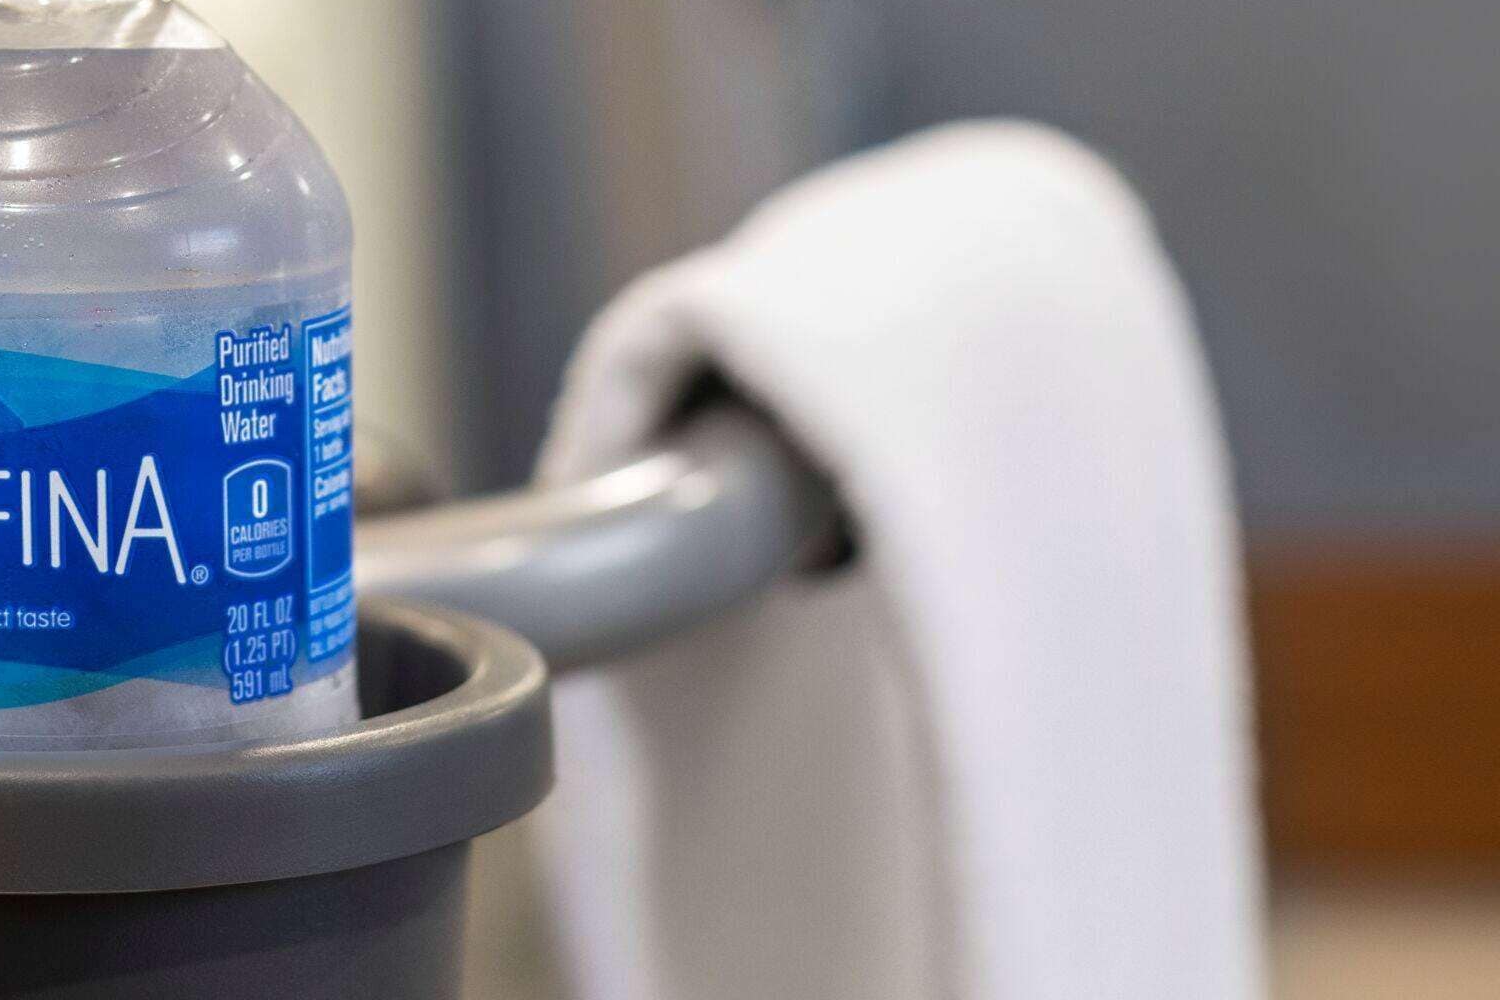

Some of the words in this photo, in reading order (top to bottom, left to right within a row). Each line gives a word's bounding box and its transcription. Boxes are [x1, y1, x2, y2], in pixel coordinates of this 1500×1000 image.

[219, 327, 290, 369] Purified
[220, 368, 294, 407] Drinking
[220, 408, 277, 444] Water
[252, 479, 269, 519] 0
[230, 518, 288, 545] CALORIES
[232, 545, 252, 563] PER
[255, 541, 286, 561] BOTTLE
[16, 608, 71, 628] taste
[227, 604, 248, 635] 20
[253, 601, 271, 630] FL
[275, 596, 294, 624] OZ
[224, 635, 267, 673] (1.25
[271, 628, 296, 661] PT)
[232, 670, 263, 701] 591
[269, 664, 290, 693] mL
